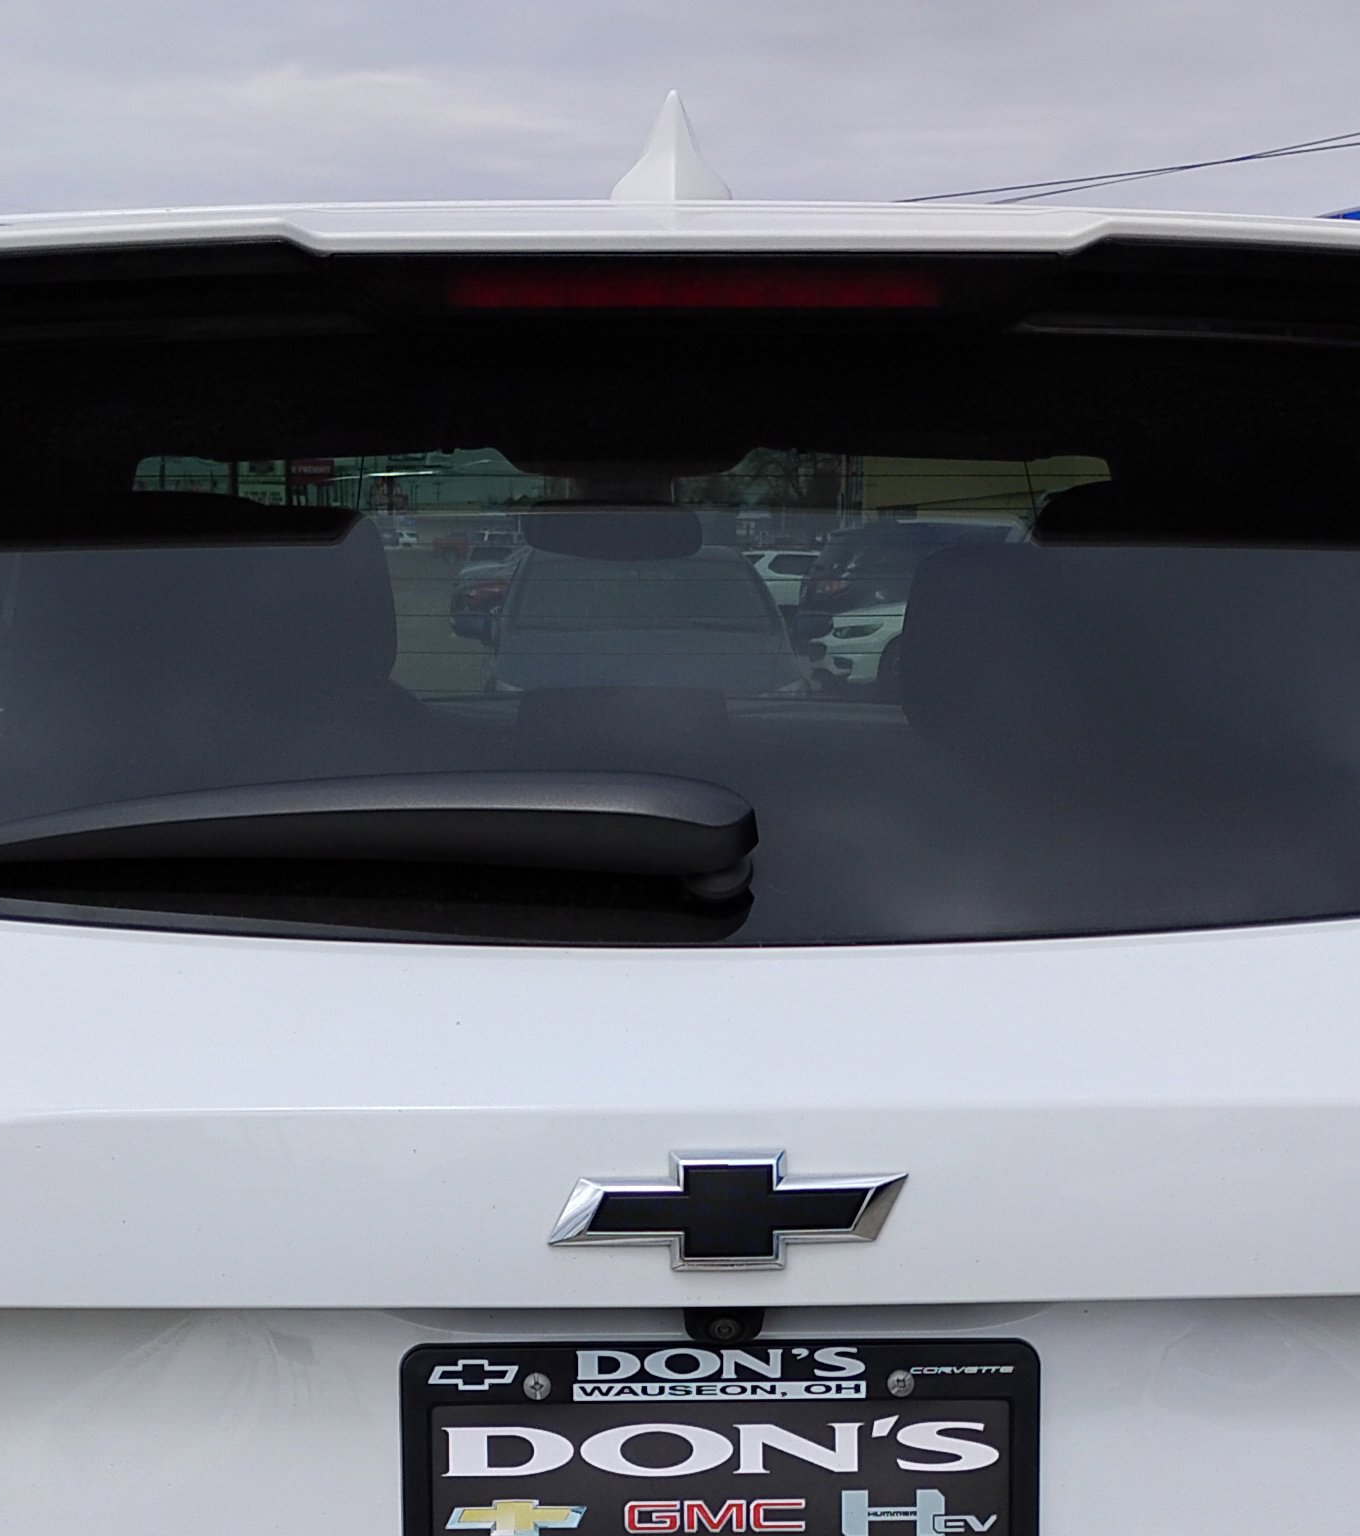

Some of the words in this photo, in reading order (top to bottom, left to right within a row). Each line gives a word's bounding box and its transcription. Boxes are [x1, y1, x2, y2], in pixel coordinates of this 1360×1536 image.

[575, 1347, 867, 1381] DON'S
[909, 1365, 1015, 1375] CORVETTE
[577, 1384, 788, 1398] WAUSEON,
[803, 1382, 862, 1396] OH
[440, 1413, 1001, 1478] DON'S
[623, 1499, 806, 1535] GMC
